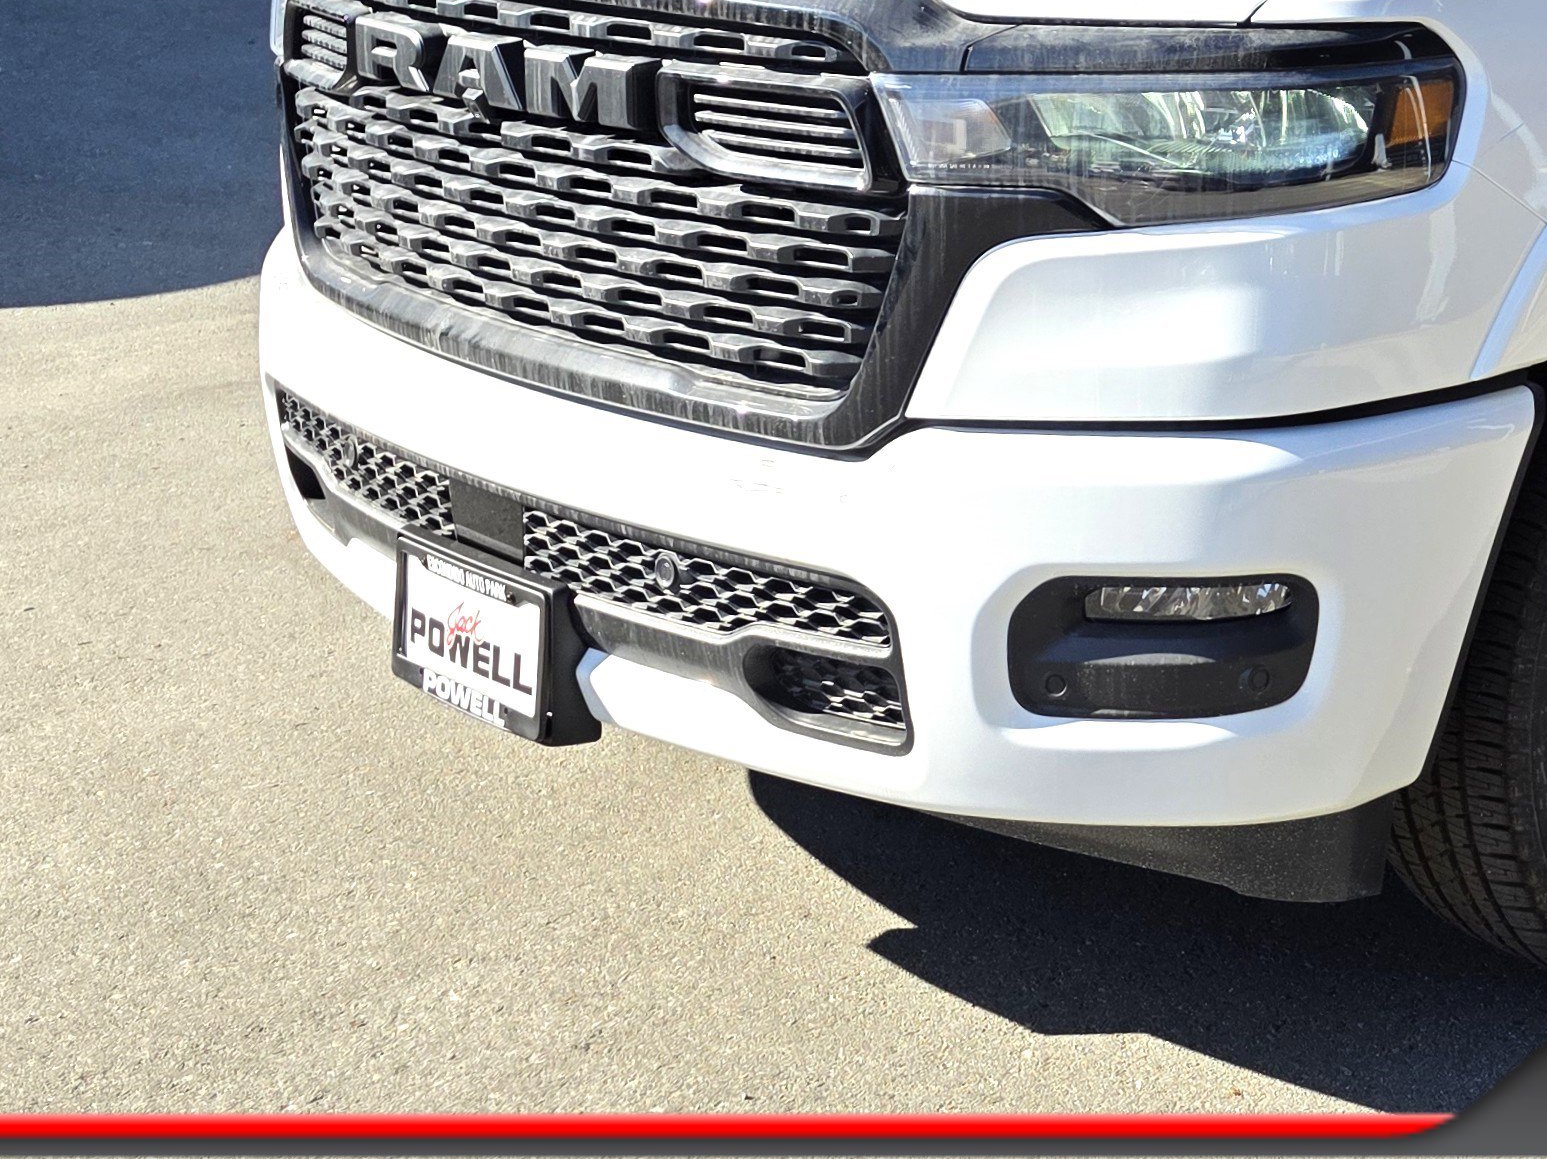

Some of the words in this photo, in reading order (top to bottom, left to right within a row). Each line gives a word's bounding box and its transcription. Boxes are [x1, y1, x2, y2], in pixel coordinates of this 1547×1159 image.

[354, 11, 661, 131] RAM
[410, 607, 533, 696] POWELL
[446, 601, 484, 646] Jack
[422, 668, 506, 728] POWELL
